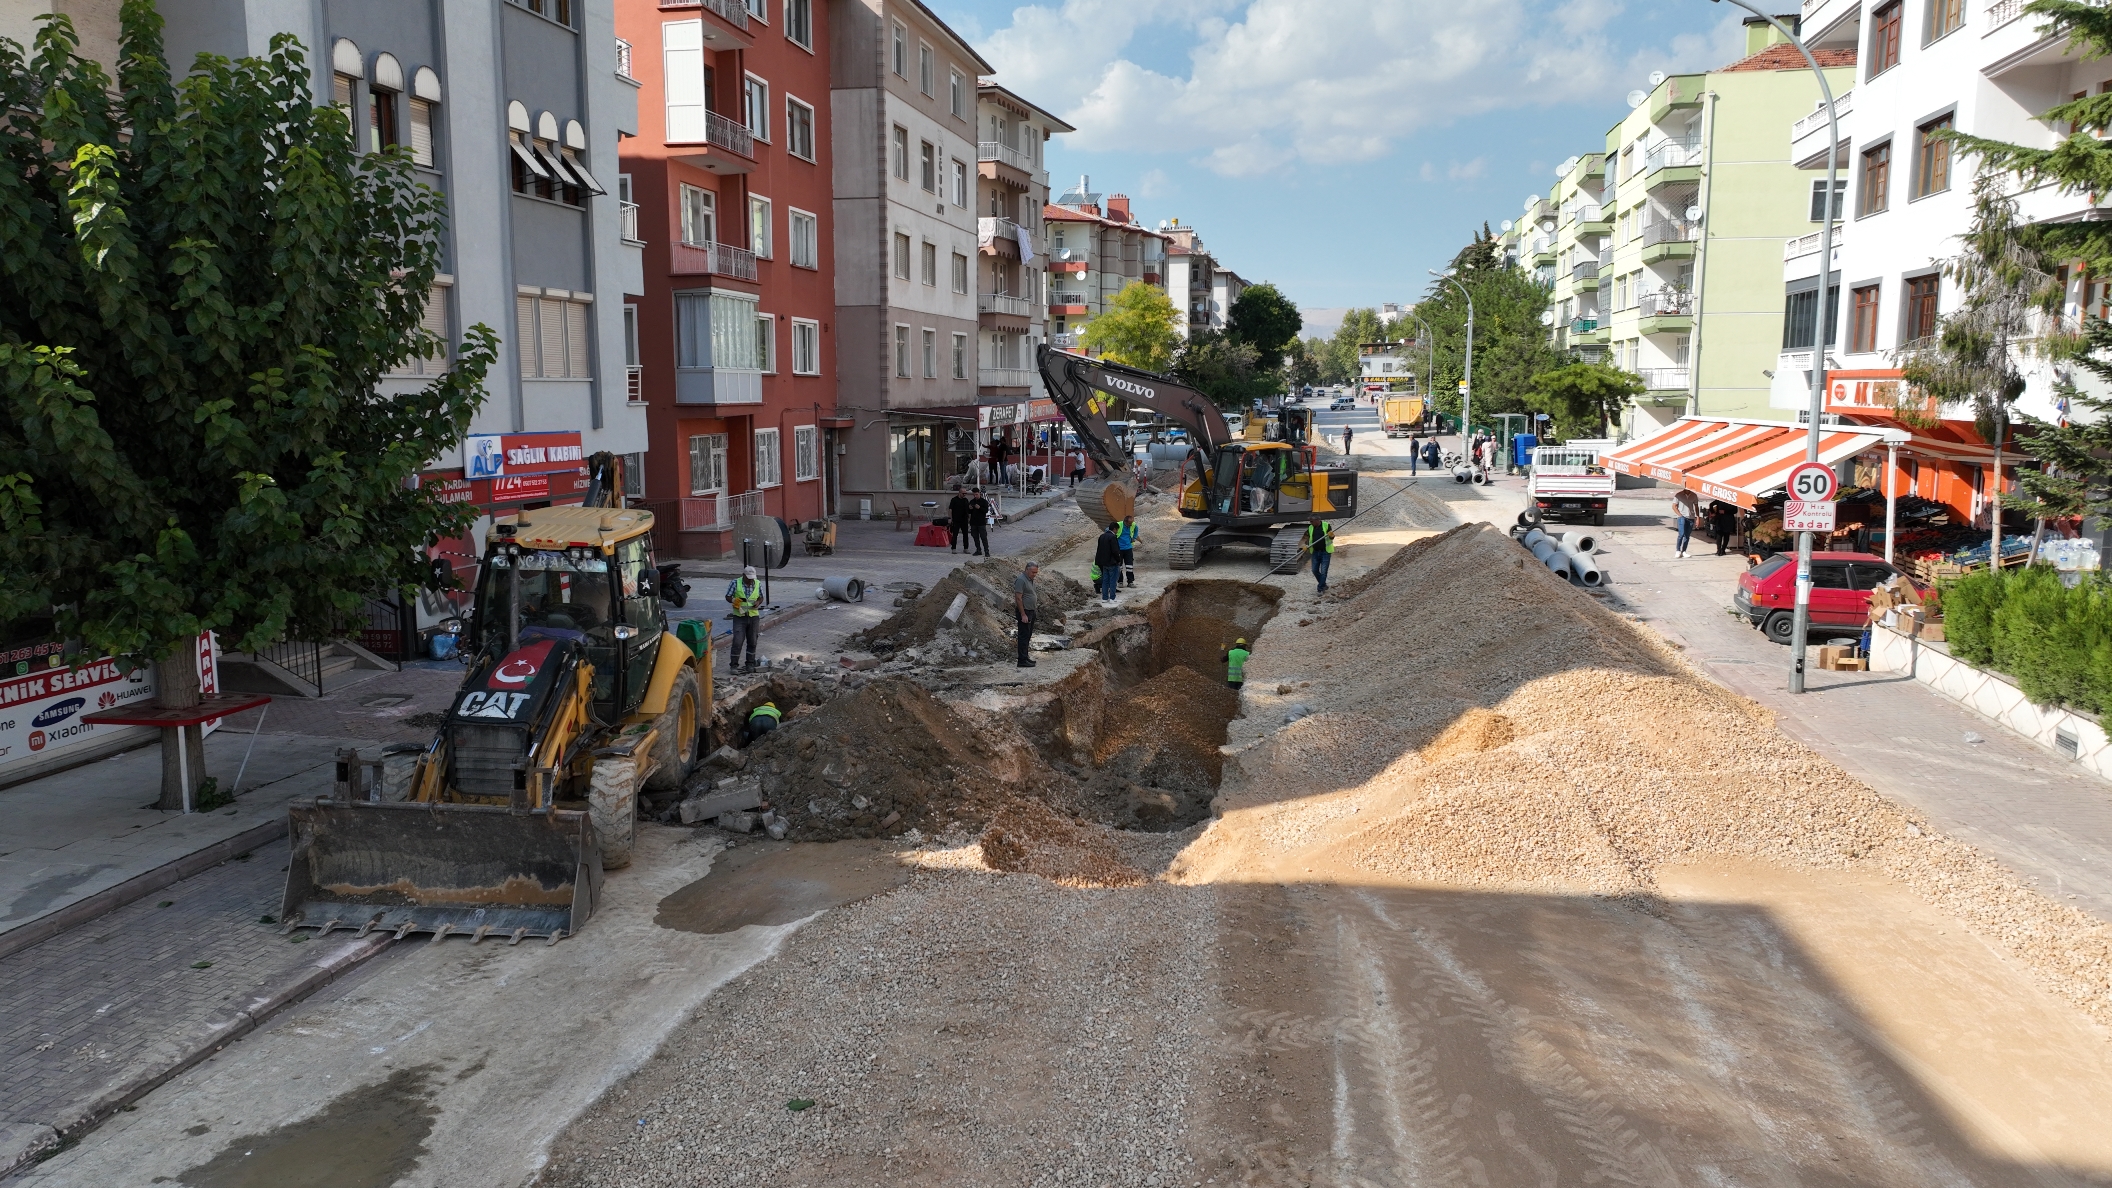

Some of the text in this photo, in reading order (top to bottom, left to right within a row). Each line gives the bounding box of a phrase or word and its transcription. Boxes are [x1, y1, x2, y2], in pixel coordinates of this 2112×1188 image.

[1104, 374, 1155, 399] VOLVO
[470, 453, 503, 477] ALP
[508, 445, 547, 466] SAĞLIK
[1607, 460, 1630, 473] AK GROSS
[1650, 467, 1672, 480] AK GROSS
[573, 478, 591, 490] HİZME
[1701, 483, 1738, 503] AK GROSS
[1797, 475, 1827, 494] 50
[1787, 520, 1830, 528] Radar
[10, 647, 33, 663] 263
[34, 643, 49, 656] 45
[50, 641, 64, 653] 79
[116, 685, 152, 700] HUAWEI
[39, 703, 80, 721] SAMSUNG
[457, 691, 531, 719] CAT
